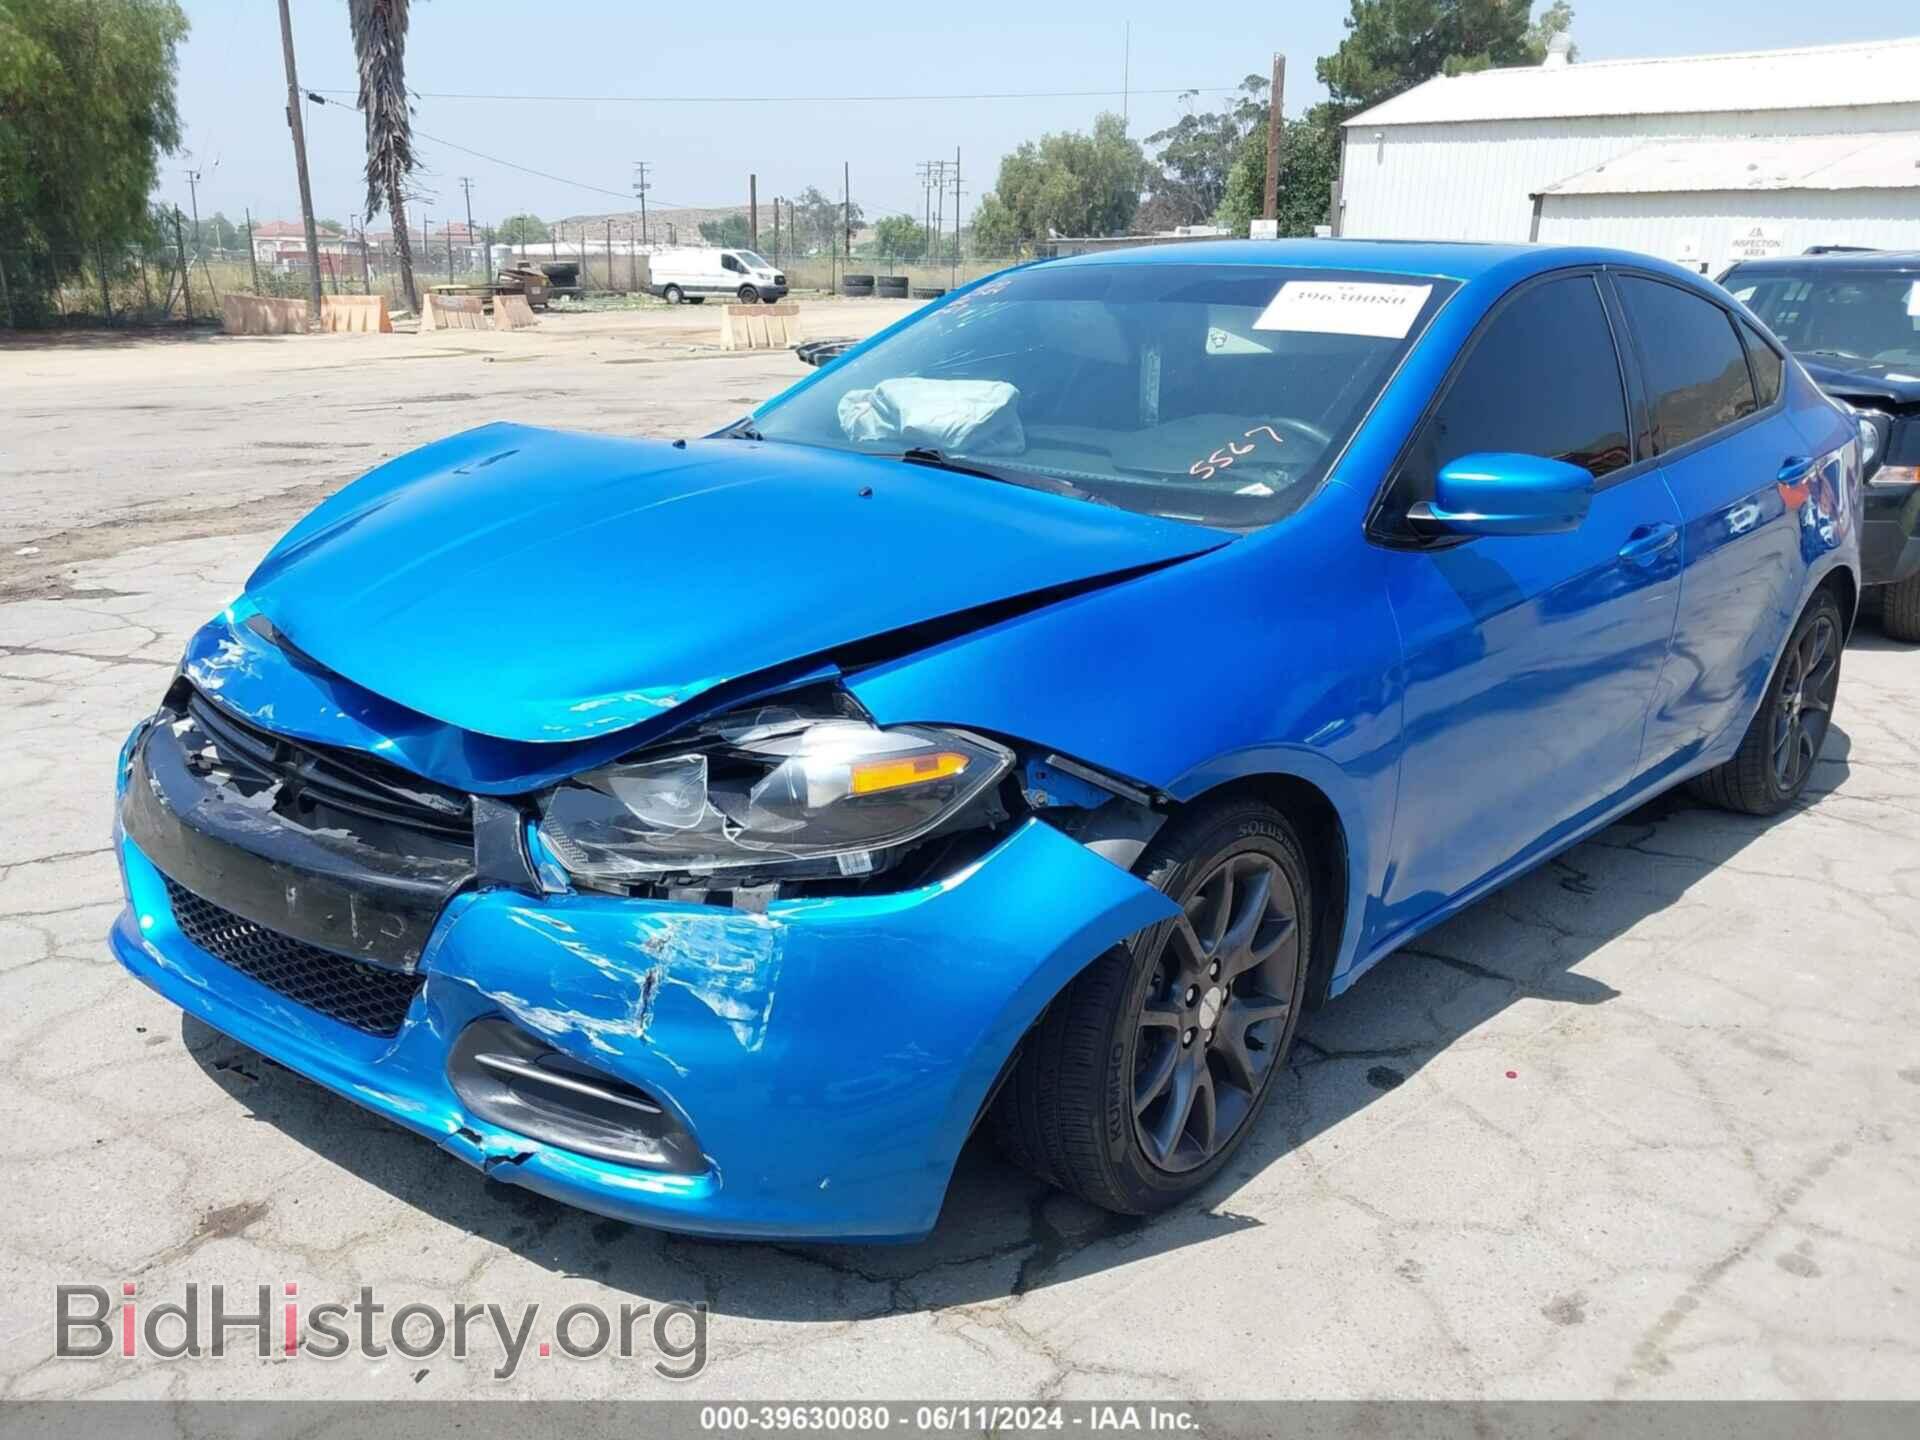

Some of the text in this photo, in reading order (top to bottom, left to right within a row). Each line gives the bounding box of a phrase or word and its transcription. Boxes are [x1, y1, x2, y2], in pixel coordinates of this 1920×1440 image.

[1731, 239, 1781, 248] INSPECTION
[1188, 426, 1284, 480] 5567
[1108, 1042, 1124, 1143] KUMHO
